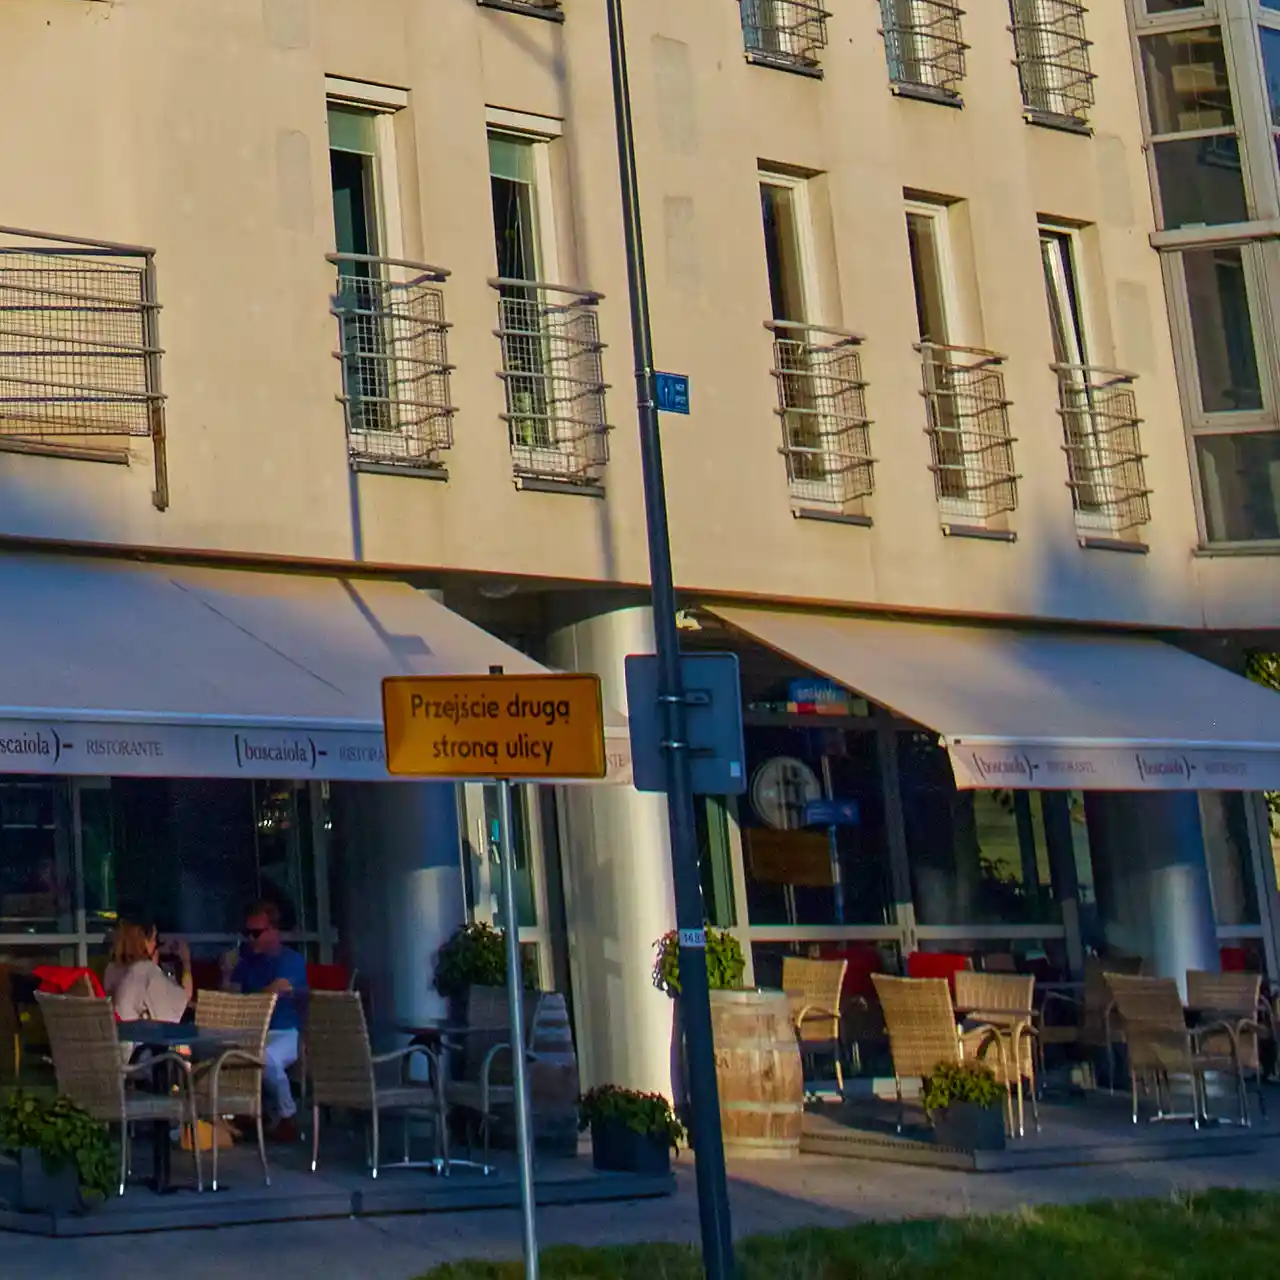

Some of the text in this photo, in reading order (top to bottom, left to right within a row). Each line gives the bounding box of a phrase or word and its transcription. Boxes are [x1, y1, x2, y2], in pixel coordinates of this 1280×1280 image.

[411, 693, 571, 726] Przejście drugą
[86, 739, 164, 756] RISTORANTE
[432, 733, 553, 766] stroną ulicy
